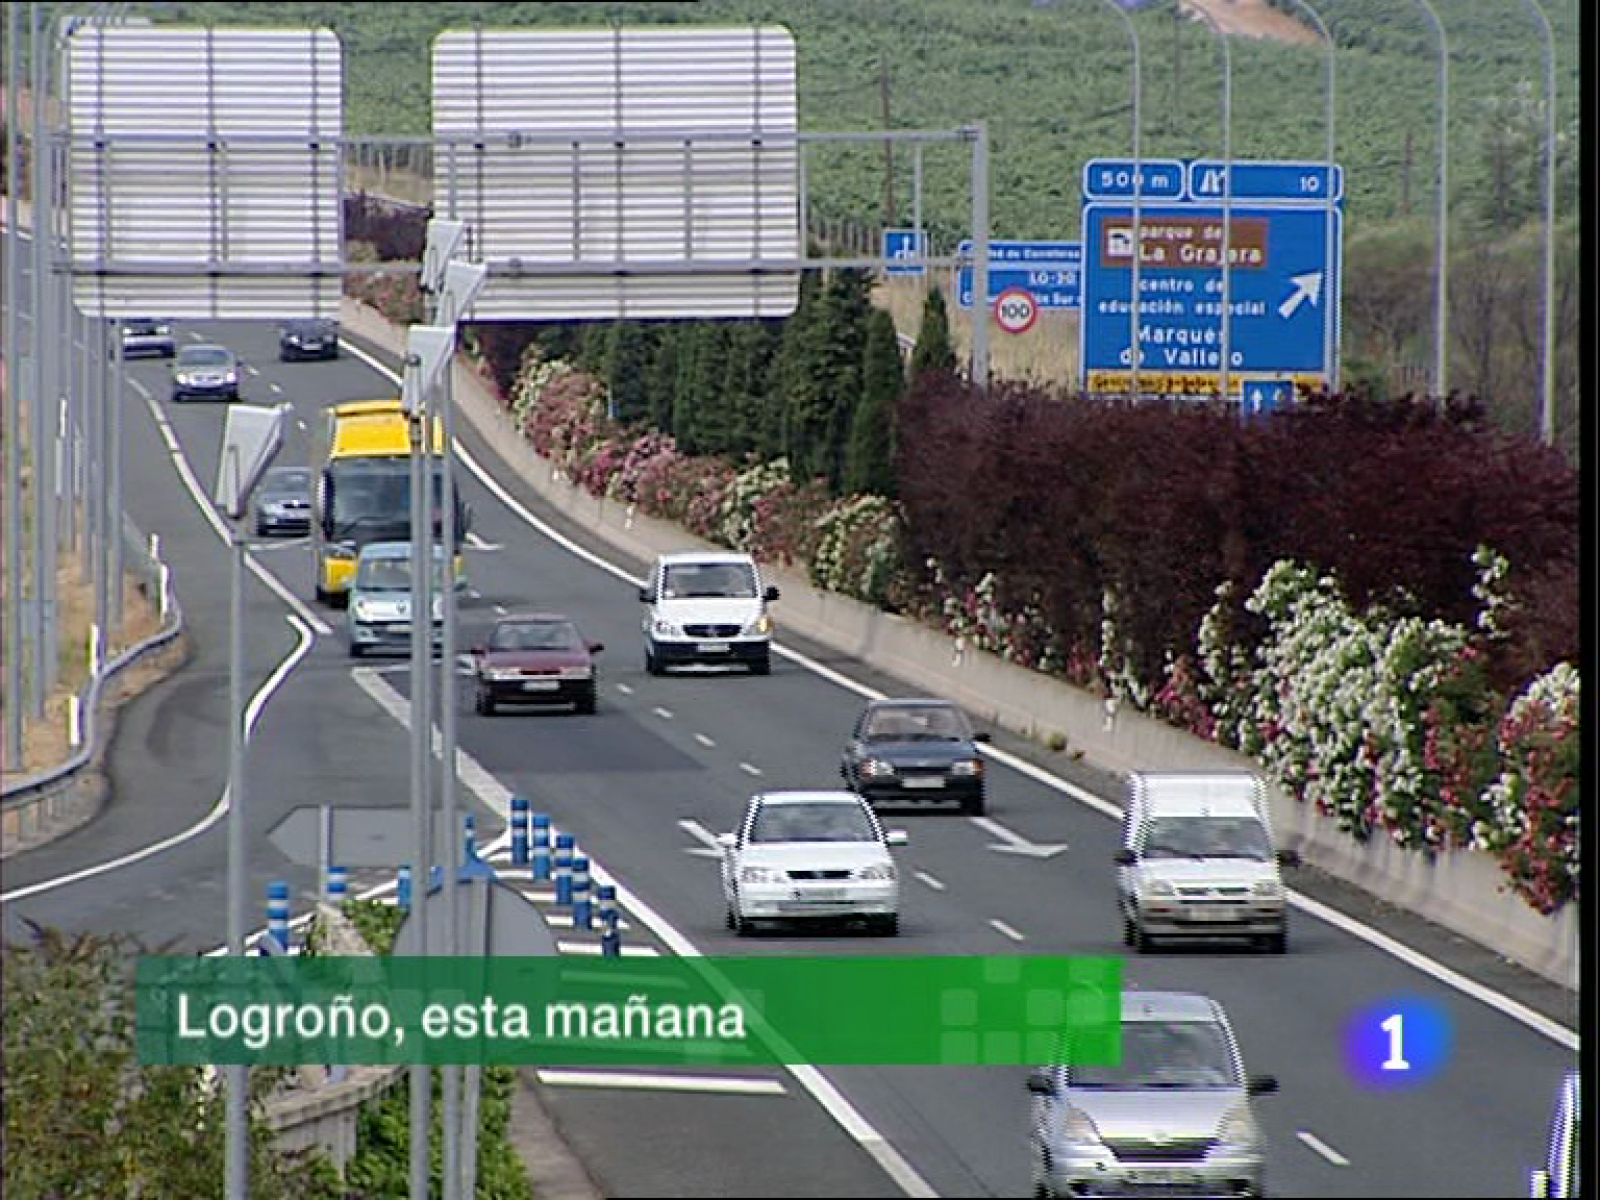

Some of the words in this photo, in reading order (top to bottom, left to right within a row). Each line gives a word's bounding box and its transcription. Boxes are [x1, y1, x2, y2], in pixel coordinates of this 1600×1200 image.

[1101, 170, 1145, 188] 500
[1151, 173, 1169, 188] m
[1299, 175, 1321, 192] 10
[1138, 243, 1166, 262] La
[1138, 276, 1195, 293] centro
[1001, 302, 1030, 320] 100
[1097, 300, 1185, 315] eduación
[1163, 347, 1244, 367] Valleo
